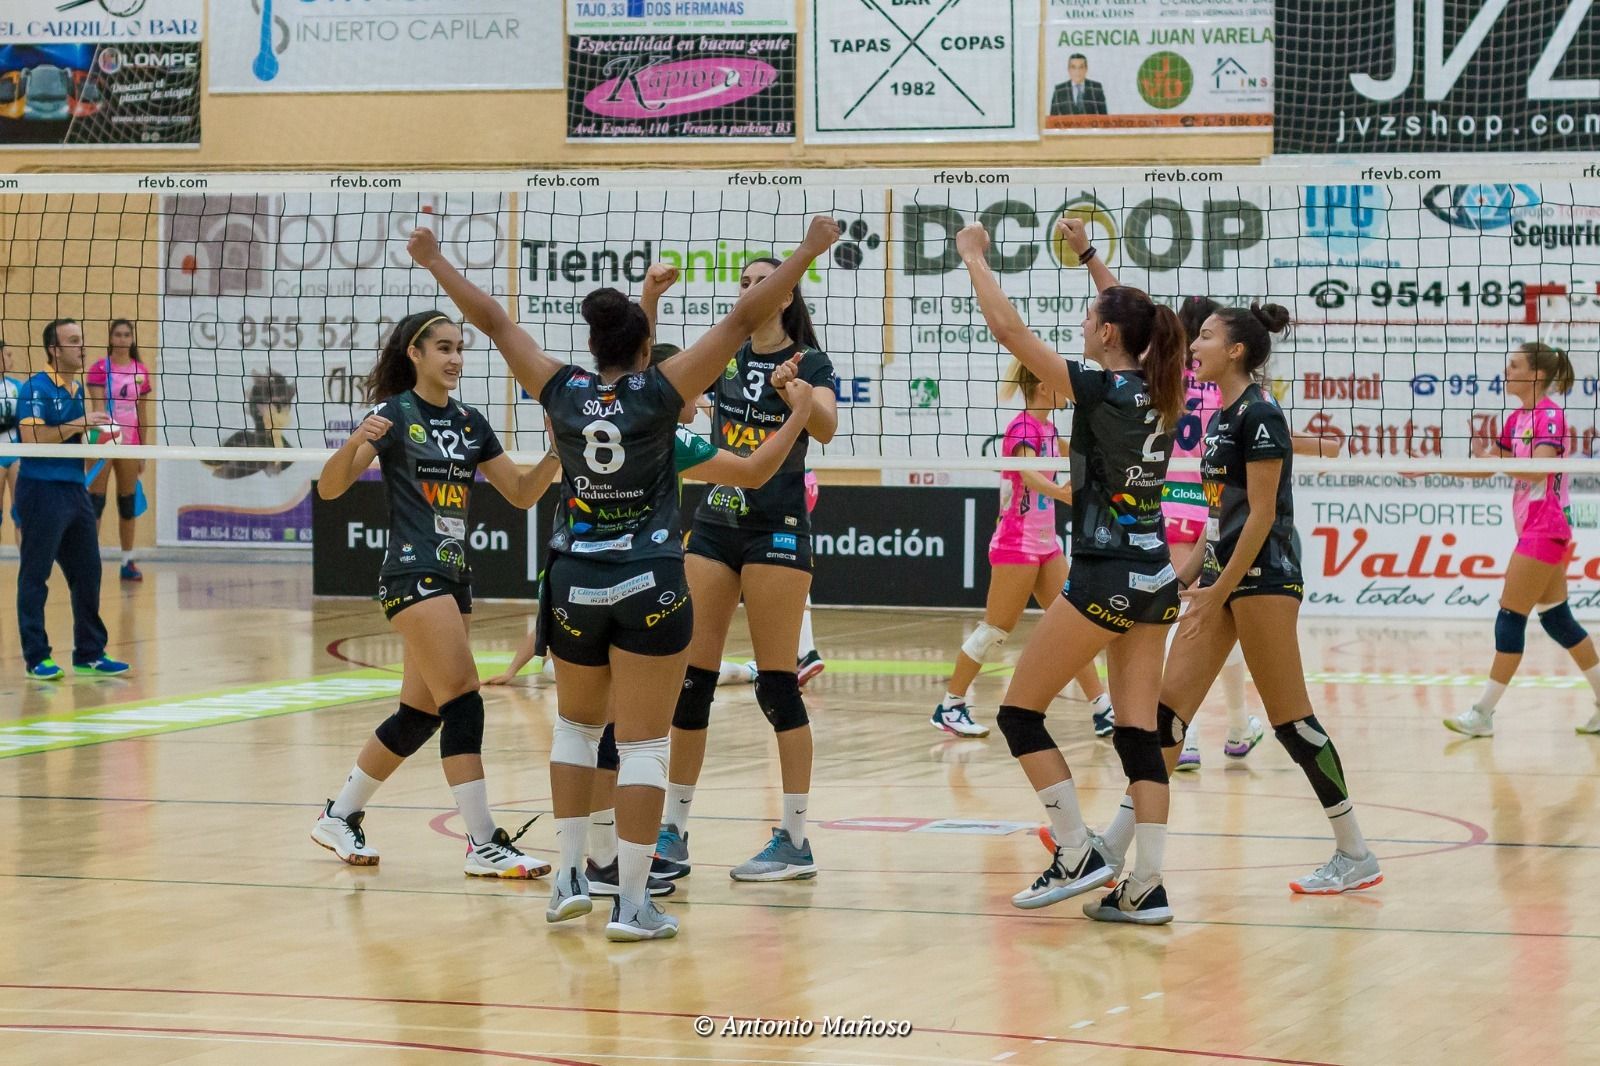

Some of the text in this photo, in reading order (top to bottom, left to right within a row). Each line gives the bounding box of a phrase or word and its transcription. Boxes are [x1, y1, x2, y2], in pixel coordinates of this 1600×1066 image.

[646, 3, 671, 16] DOS
[675, 2, 744, 15] HERMANAS
[27, 20, 142, 36] CARRILLO
[151, 19, 197, 36] BAR
[296, 18, 520, 42] INJERTO CAPILAR
[576, 35, 790, 54] Especialidad en buena gente
[941, 35, 1005, 51] COPAS
[1058, 27, 1274, 47] AGENCIA JUAN VARELA
[830, 38, 891, 53] TAPAS
[1350, 0, 1600, 100] JVZ
[111, 78, 165, 93] Descubre el
[890, 82, 936, 96] 1982
[1240, 76, 1273, 89] INS
[119, 86, 194, 105] placer de viajar
[111, 115, 191, 125] www.alompe.com
[1336, 110, 1600, 142] jvzshop.com
[574, 122, 599, 134] Avd.
[601, 122, 646, 136] España,
[648, 122, 669, 134] 110
[683, 122, 718, 135] Frente
[720, 125, 728, 134] a
[729, 122, 774, 137] parking
[775, 122, 791, 134] B3
[527, 175, 600, 187] rfevb.com
[728, 174, 802, 186] rfevb.com
[933, 171, 1010, 184] rfevb.com
[1144, 169, 1223, 182] rfevb.com
[1361, 167, 1441, 180] rfevb.com
[138, 177, 208, 188] rfevb.com
[330, 176, 401, 188] rfevb.com
[1371, 280, 1445, 307] 954
[1457, 280, 1527, 307] 183
[1037, 296, 1074, 313] 900
[237, 315, 304, 347] 955
[317, 315, 359, 347] 52
[120, 384, 128, 398] 4
[743, 370, 765, 402] 3
[1303, 372, 1381, 400] Hostal
[719, 402, 785, 423] ndación Cajasol
[1142, 408, 1165, 462] 2
[1302, 412, 1442, 458] Santa
[431, 429, 465, 460] 12
[582, 420, 626, 474] 8
[418, 466, 447, 474] Fundación
[1298, 474, 1514, 490] DE CELEBRACIONES BODAS BAUTIZ
[574, 483, 644, 499] Producciones
[1172, 488, 1207, 501] Global
[1312, 502, 1502, 526] TRANSPORTES
[809, 527, 944, 557] ndación
[611, 575, 650, 595] Frontela
[622, 582, 650, 597] CAPILAR
[1308, 581, 1490, 605] en todos los
